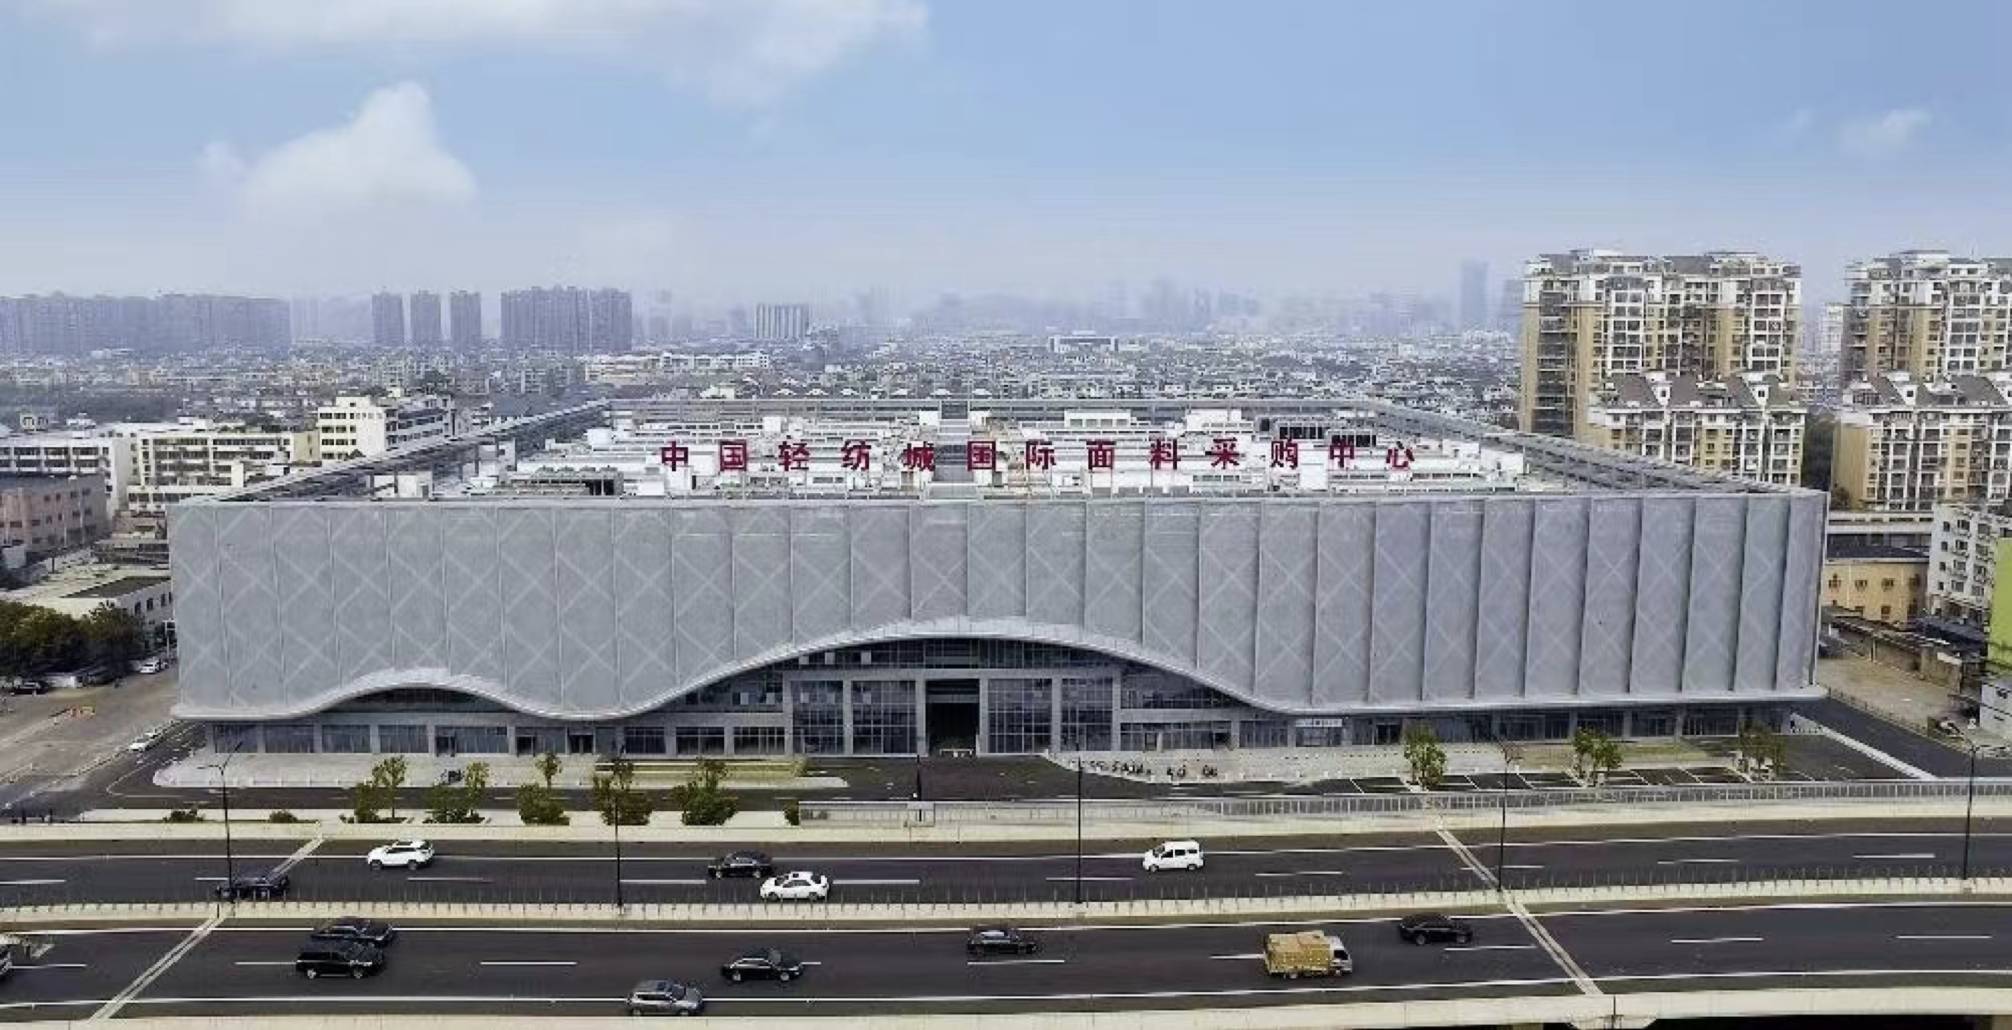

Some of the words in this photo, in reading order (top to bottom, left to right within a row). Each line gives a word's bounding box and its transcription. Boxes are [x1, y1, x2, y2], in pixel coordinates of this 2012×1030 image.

[660, 438, 1415, 472] 中国轻纺城国际面料采购中心
